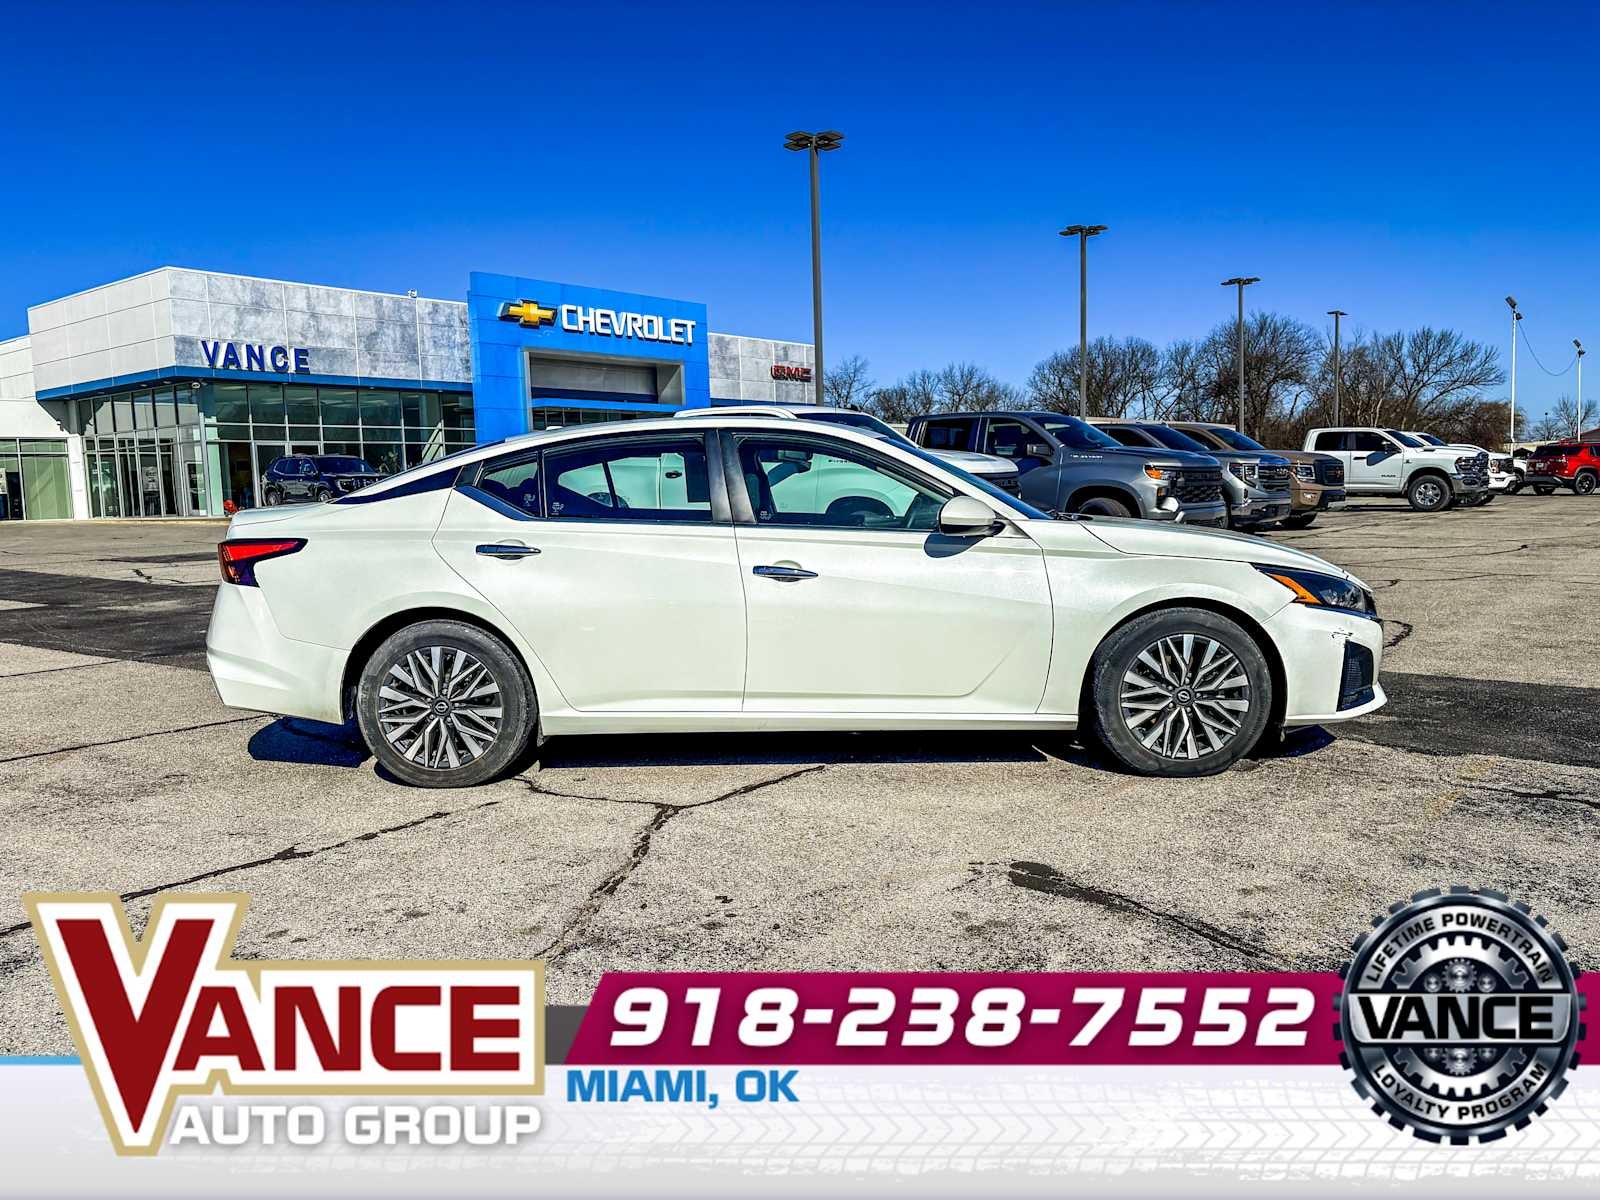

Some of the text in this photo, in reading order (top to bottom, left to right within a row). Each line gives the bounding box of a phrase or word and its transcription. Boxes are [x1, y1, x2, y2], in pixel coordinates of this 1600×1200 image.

[561, 304, 696, 345] CHEVROLET
[201, 341, 310, 374] VANCE
[771, 365, 811, 382] GMC
